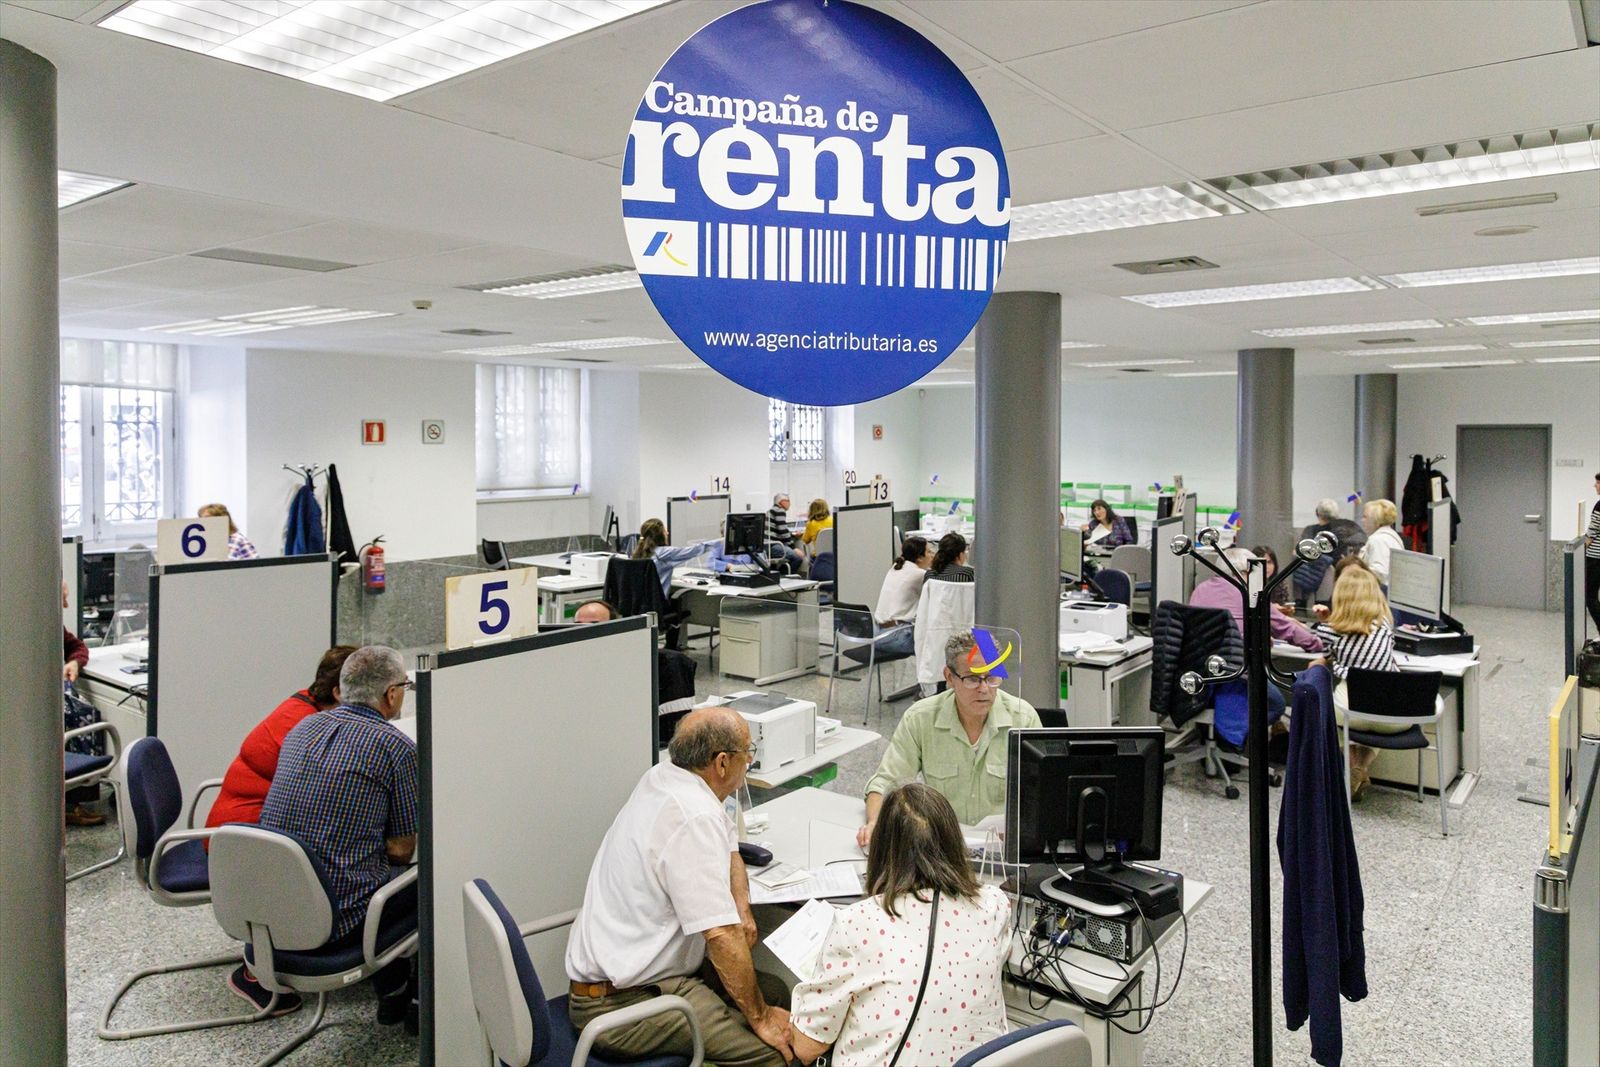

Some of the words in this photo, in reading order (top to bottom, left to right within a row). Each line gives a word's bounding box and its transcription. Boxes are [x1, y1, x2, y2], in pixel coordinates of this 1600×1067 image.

[645, 80, 828, 130] Campaña
[836, 101, 879, 132] de
[621, 114, 1011, 227] renta
[704, 330, 938, 353] www.agenciatributaria.es
[714, 476, 730, 492] 14
[845, 470, 857, 484] 20
[873, 482, 888, 500] 13
[181, 523, 207, 558] 6
[478, 580, 510, 635] 5
